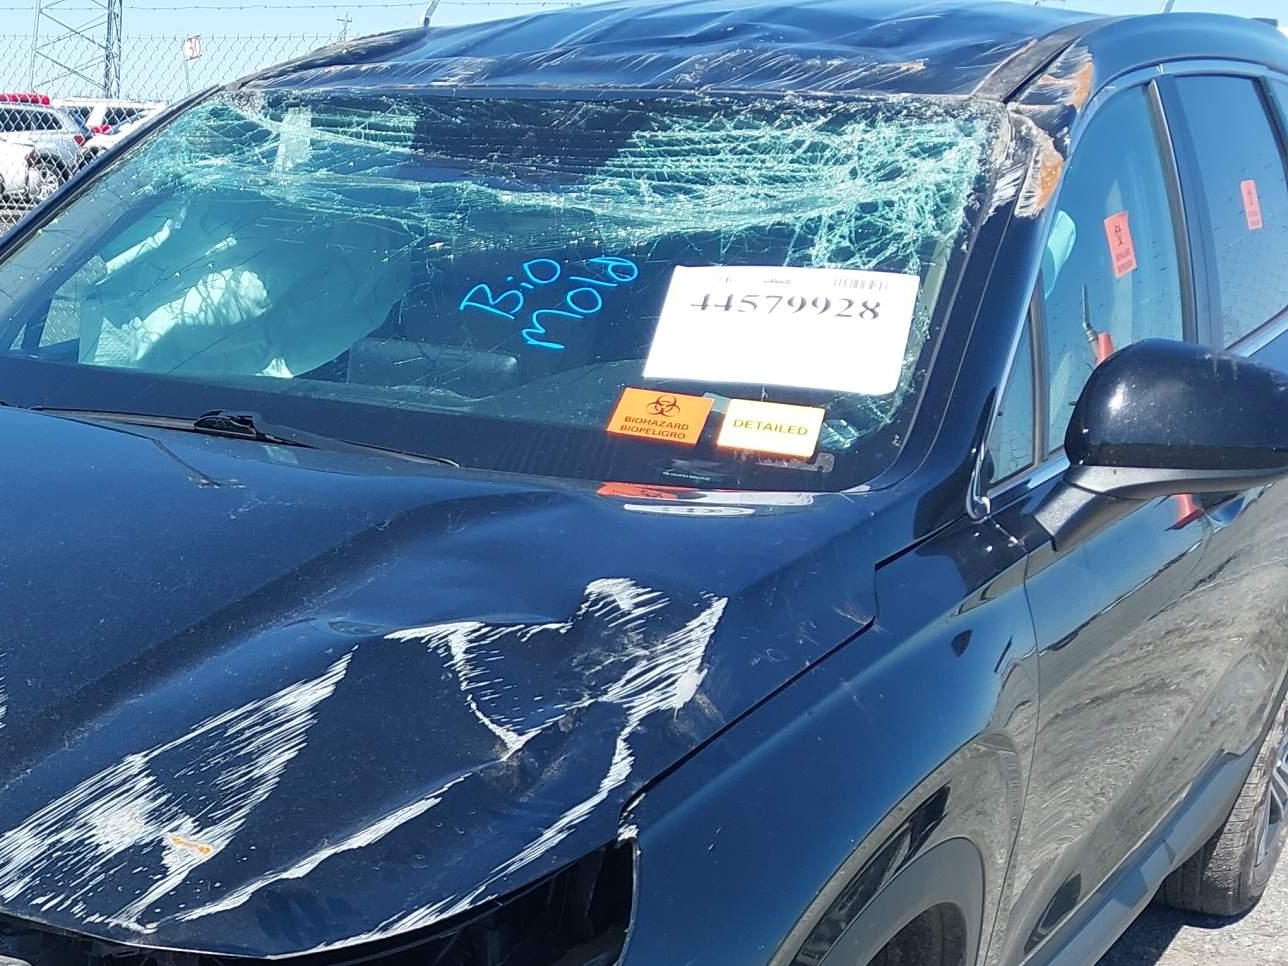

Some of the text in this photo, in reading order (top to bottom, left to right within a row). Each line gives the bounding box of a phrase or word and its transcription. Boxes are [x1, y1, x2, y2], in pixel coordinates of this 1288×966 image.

[690, 293, 882, 320] 44579928
[619, 424, 687, 440] BIOPELIGRO
[623, 415, 690, 432] BIOHAZARD
[732, 418, 809, 437] DETAILED
